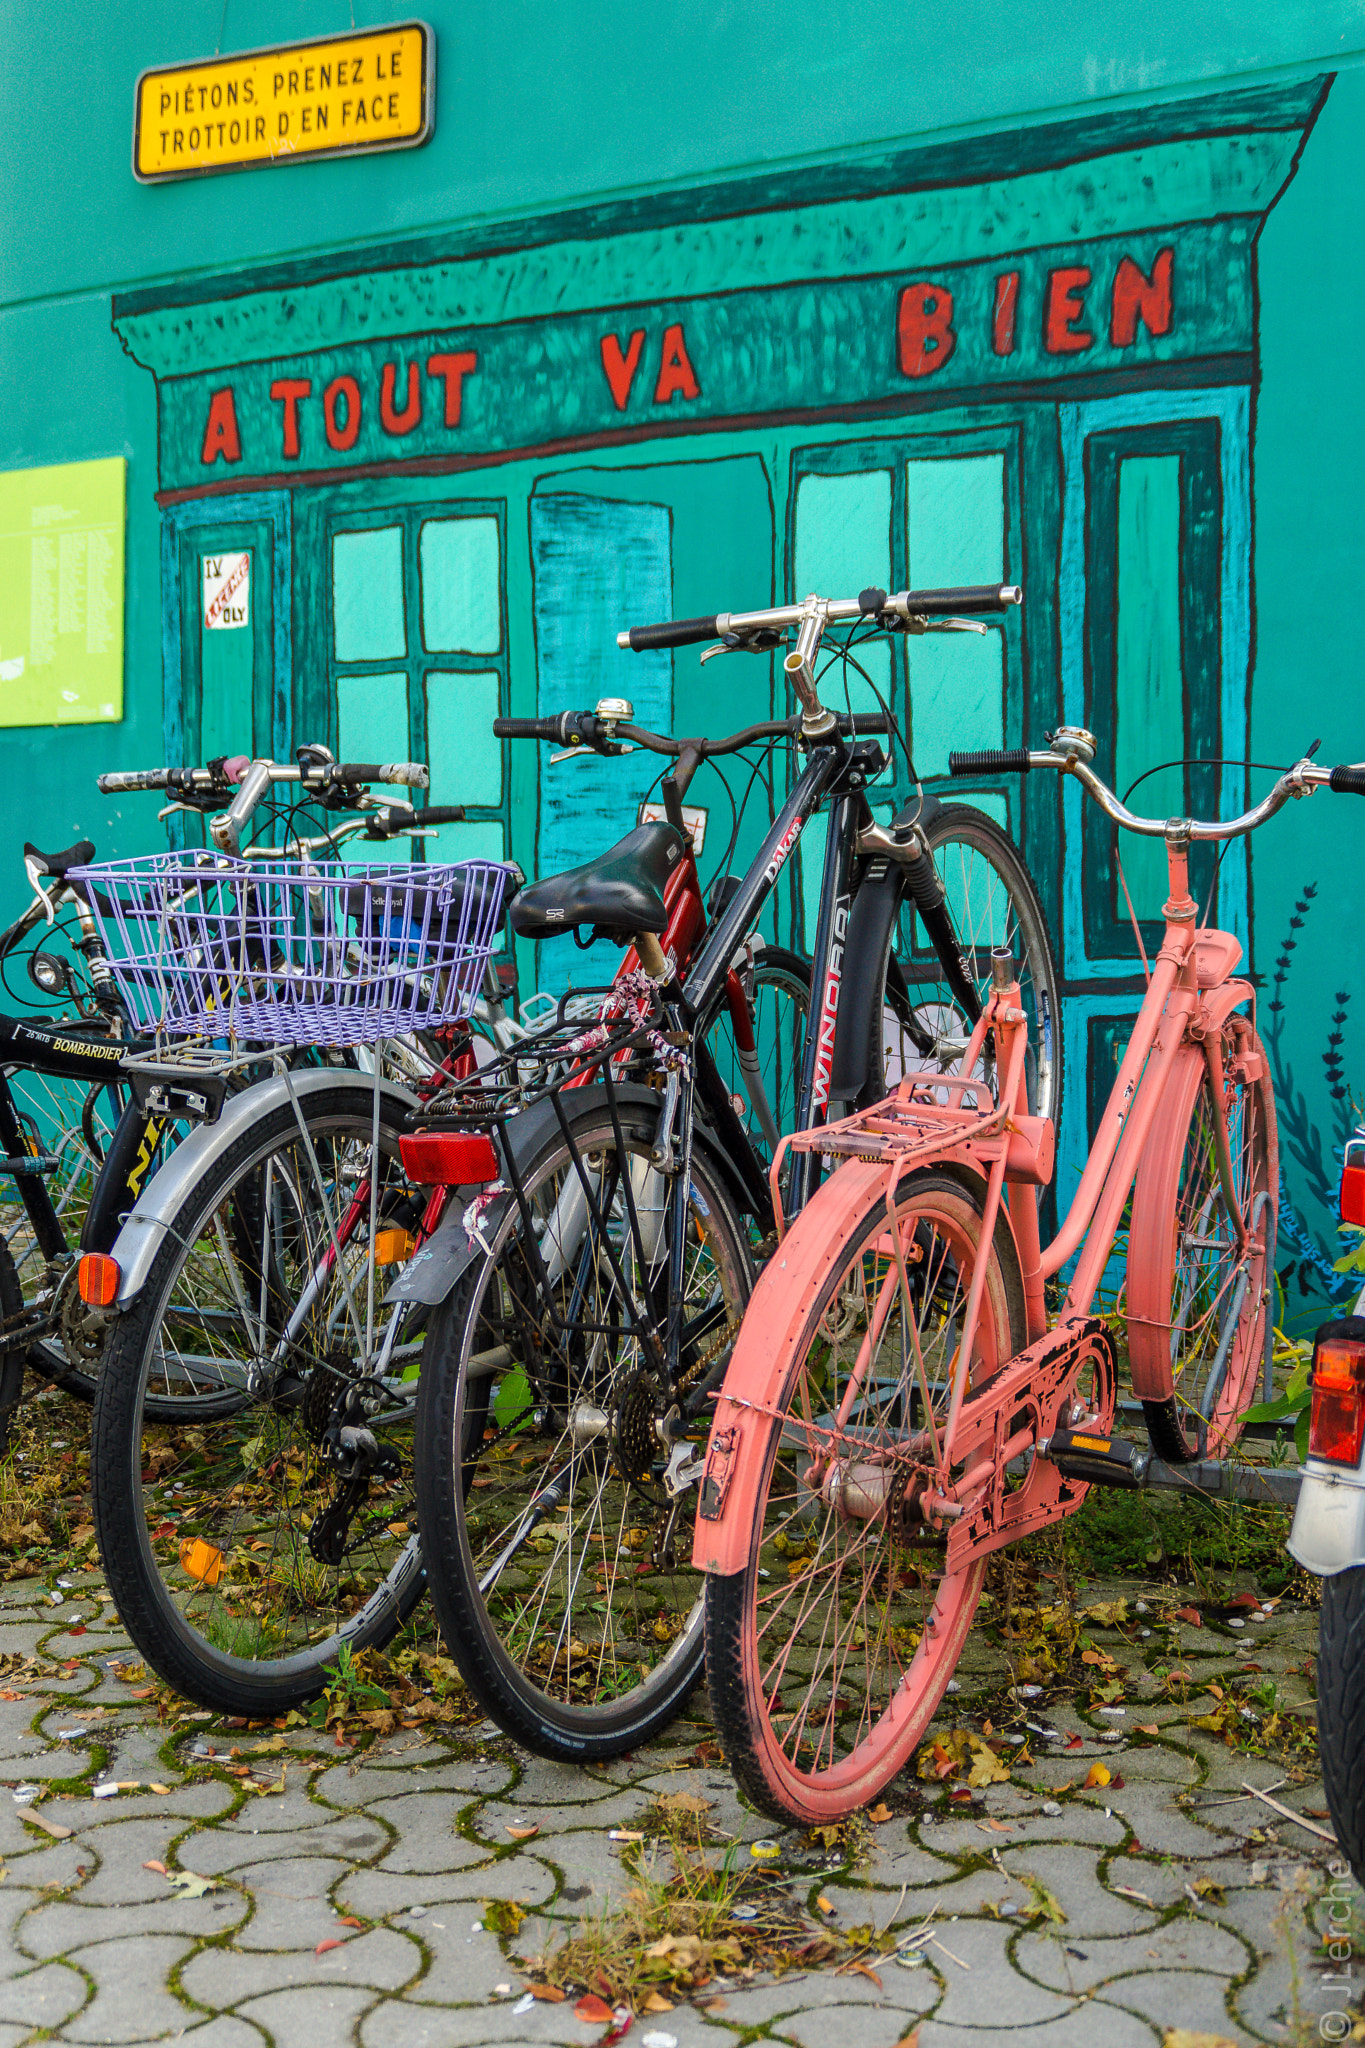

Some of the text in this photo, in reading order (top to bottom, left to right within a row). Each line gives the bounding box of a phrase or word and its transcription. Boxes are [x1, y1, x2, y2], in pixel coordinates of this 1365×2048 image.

[160, 52, 403, 118] PIÉTONS, PRENEZ LE
[160, 115, 266, 156] TROTTOIR
[278, 105, 329, 137] D'EN
[342, 92, 400, 127] FACE
[201, 246, 1174, 464] A TOUT VA BIEN
[813, 893, 851, 1106] WINORA
